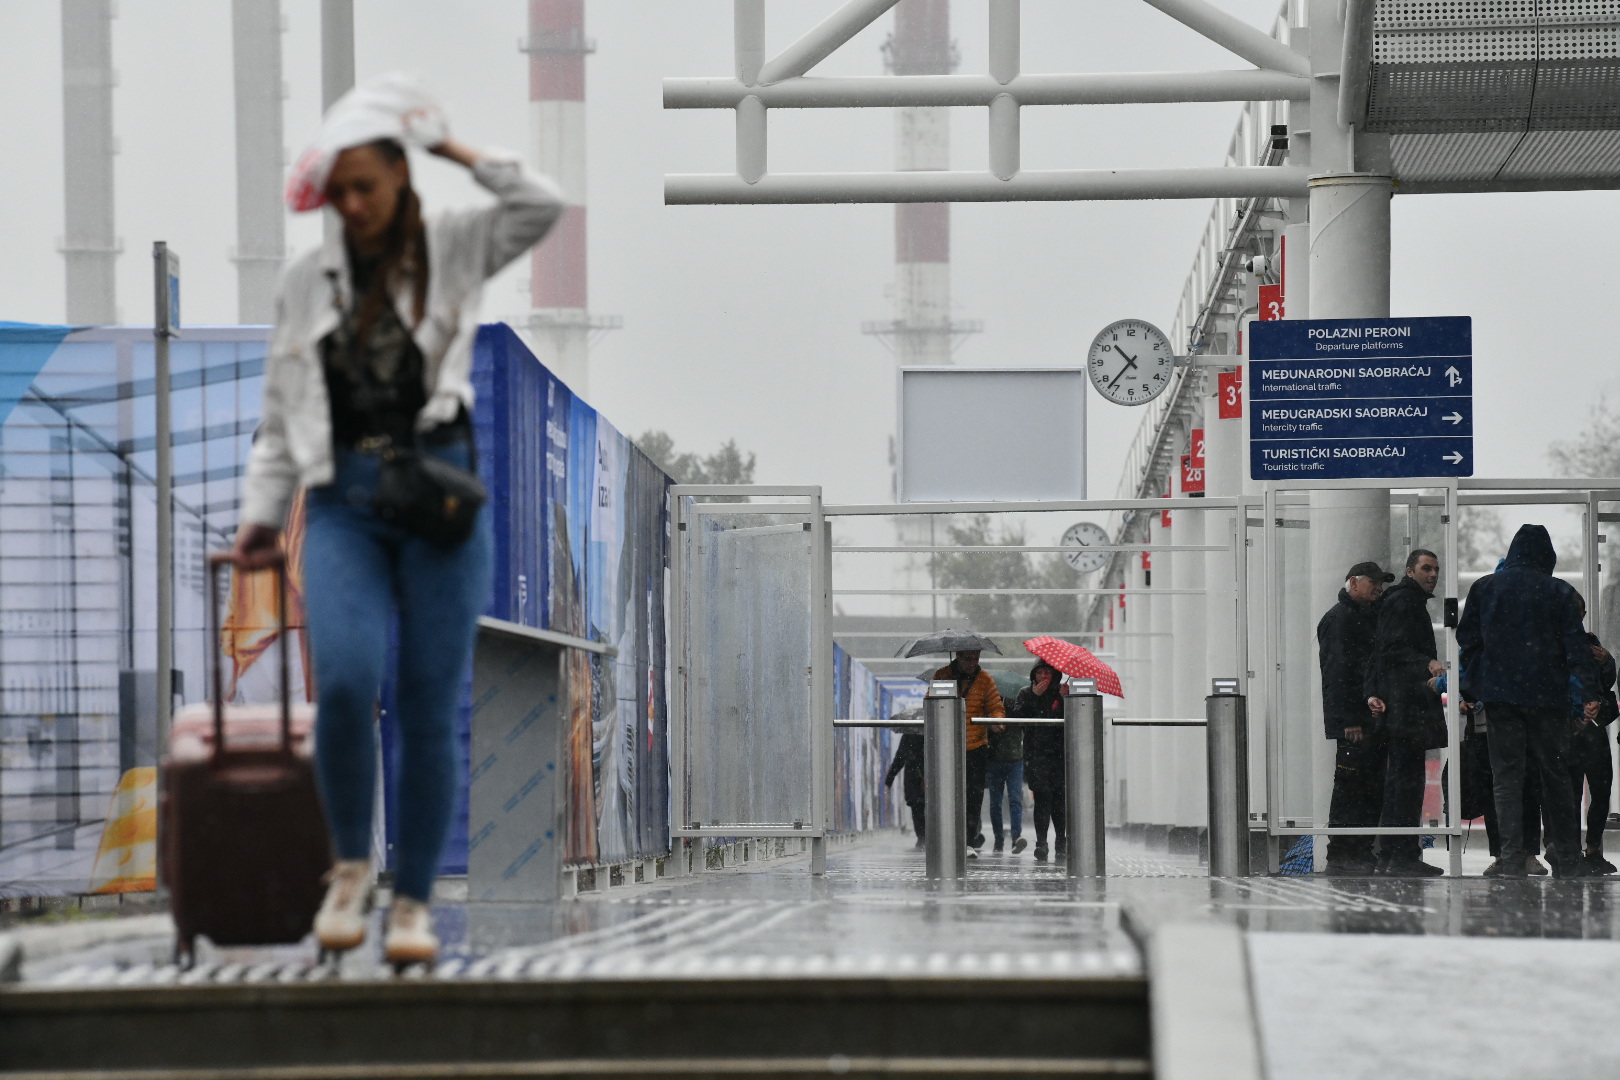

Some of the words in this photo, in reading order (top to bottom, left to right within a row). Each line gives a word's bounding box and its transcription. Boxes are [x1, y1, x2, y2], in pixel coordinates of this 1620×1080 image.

[1127, 329, 1136, 337] 12
[1308, 328, 1362, 339] POLAZNI
[1364, 326, 1411, 338] PERONI
[1101, 344, 1111, 352] 10
[1153, 343, 1160, 351] 2
[1315, 342, 1360, 352] Departure
[1361, 341, 1404, 351] platforms
[1097, 359, 1104, 367] 9
[1158, 358, 1164, 366] 3
[1262, 368, 1356, 380] MEĐUNARODNI
[1358, 365, 1431, 378] SAOBRAĆAJ
[1113, 384, 1120, 392] 7
[1142, 384, 1149, 392] 5
[1262, 383, 1316, 392] International
[1317, 382, 1342, 391] traffic
[1127, 388, 1135, 396] 6
[1262, 408, 1352, 420] MEĐUGRADSKI
[1354, 406, 1428, 418] SAOBRAĆAJ
[1262, 423, 1298, 433] Intercity
[1299, 422, 1323, 431] traffic
[1262, 446, 1330, 459] TURISTIČKI
[1333, 445, 1406, 458] SAOBRAĆAJ
[1263, 462, 1299, 471] Touristic
[1300, 462, 1325, 471] traffic
